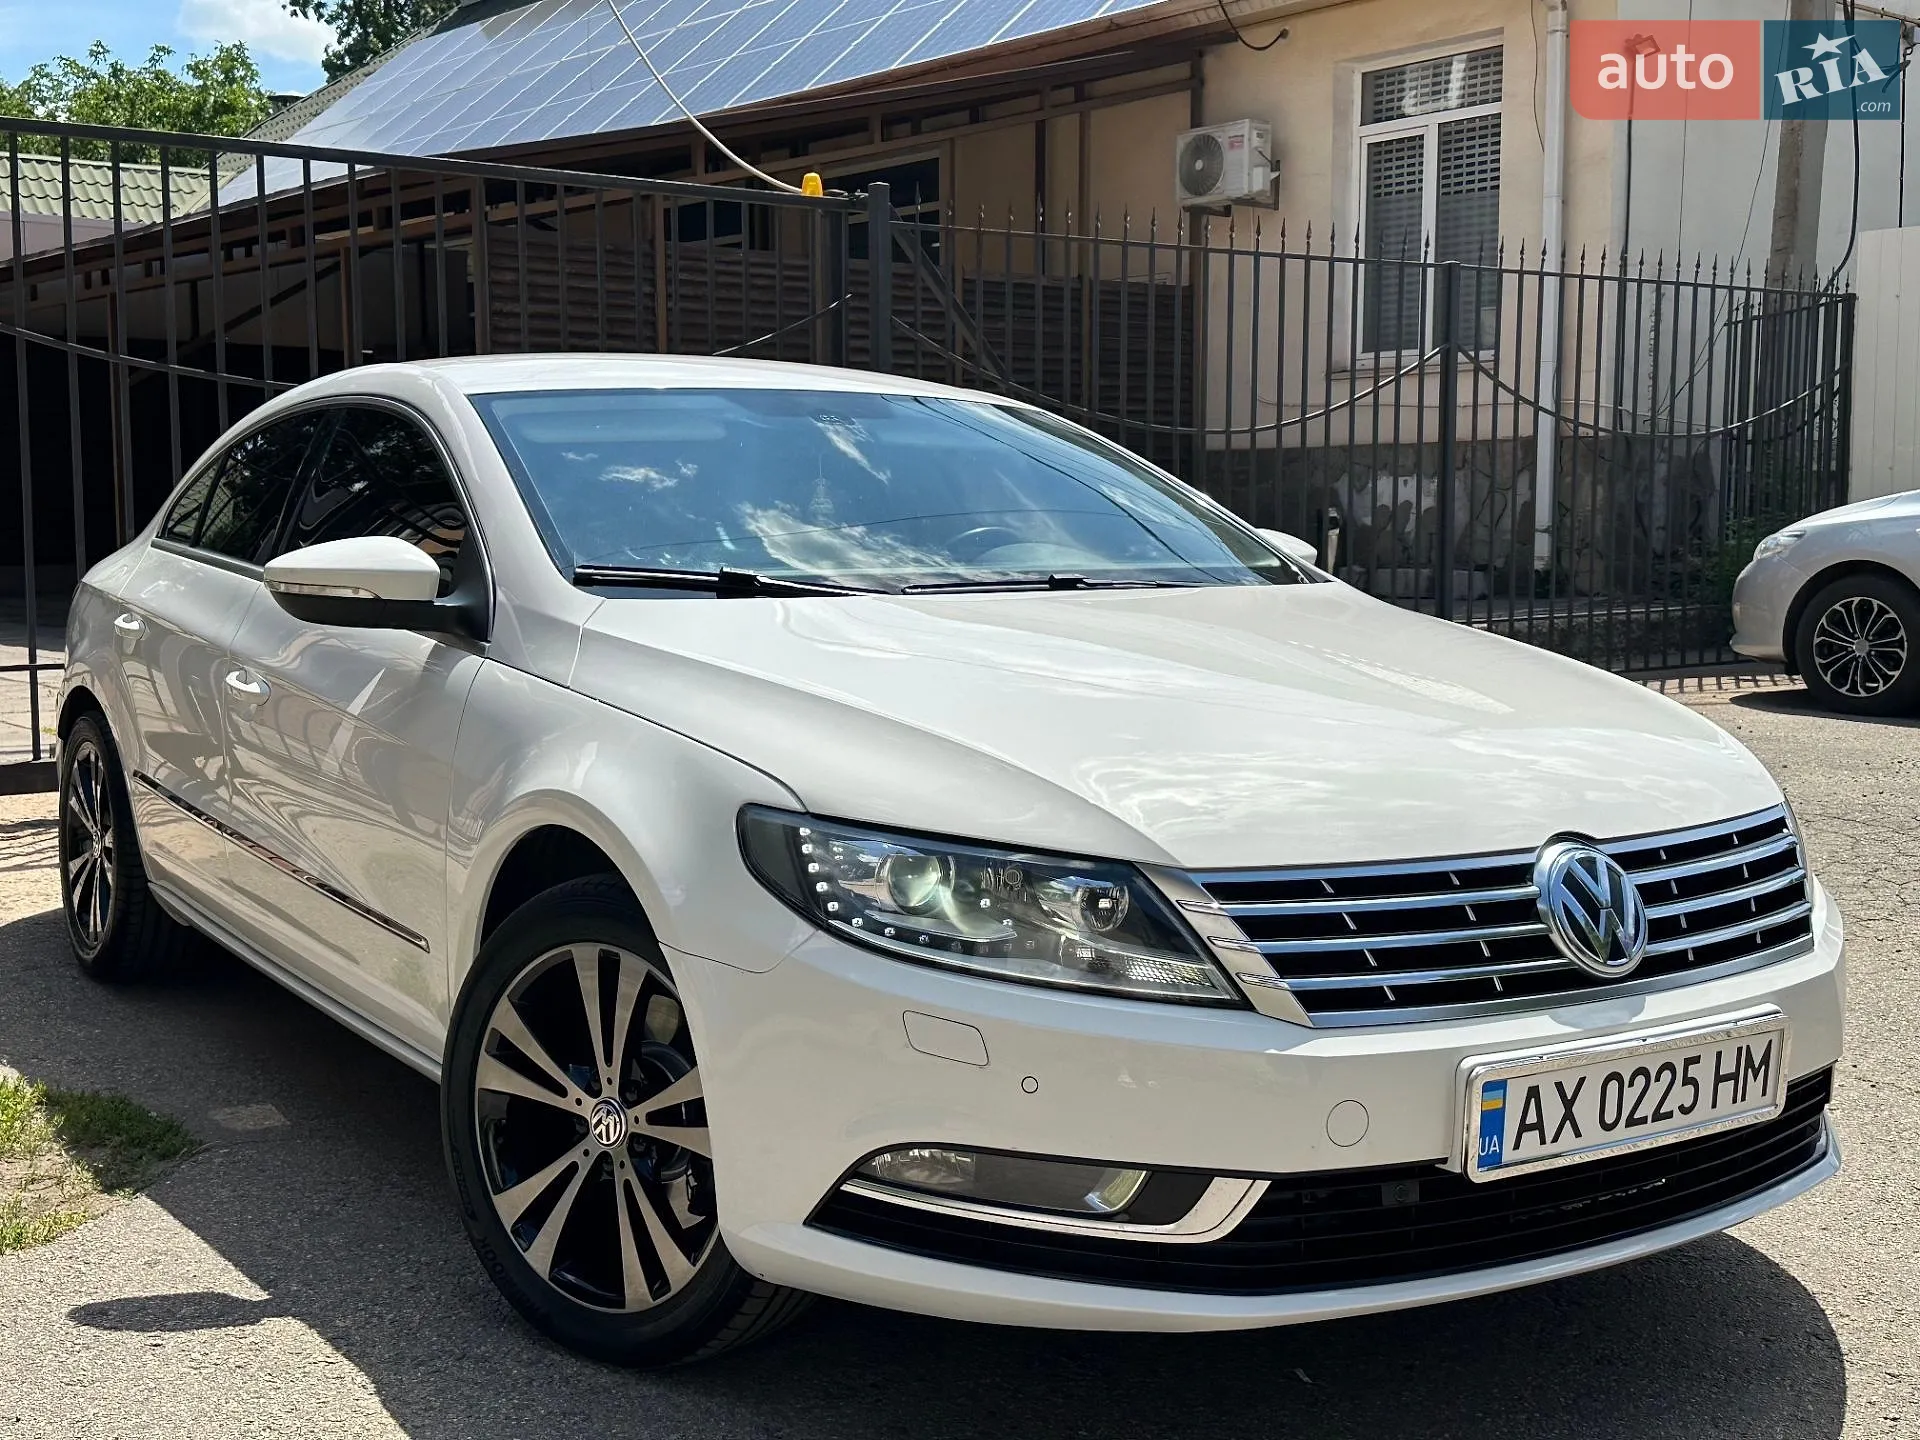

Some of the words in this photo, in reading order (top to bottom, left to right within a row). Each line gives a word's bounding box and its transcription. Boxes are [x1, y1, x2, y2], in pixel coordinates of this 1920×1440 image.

[1512, 1075, 1587, 1152] AX
[1598, 1053, 1702, 1133] 0225
[1710, 1038, 1773, 1110] HM
[1479, 1134, 1500, 1156] UA
